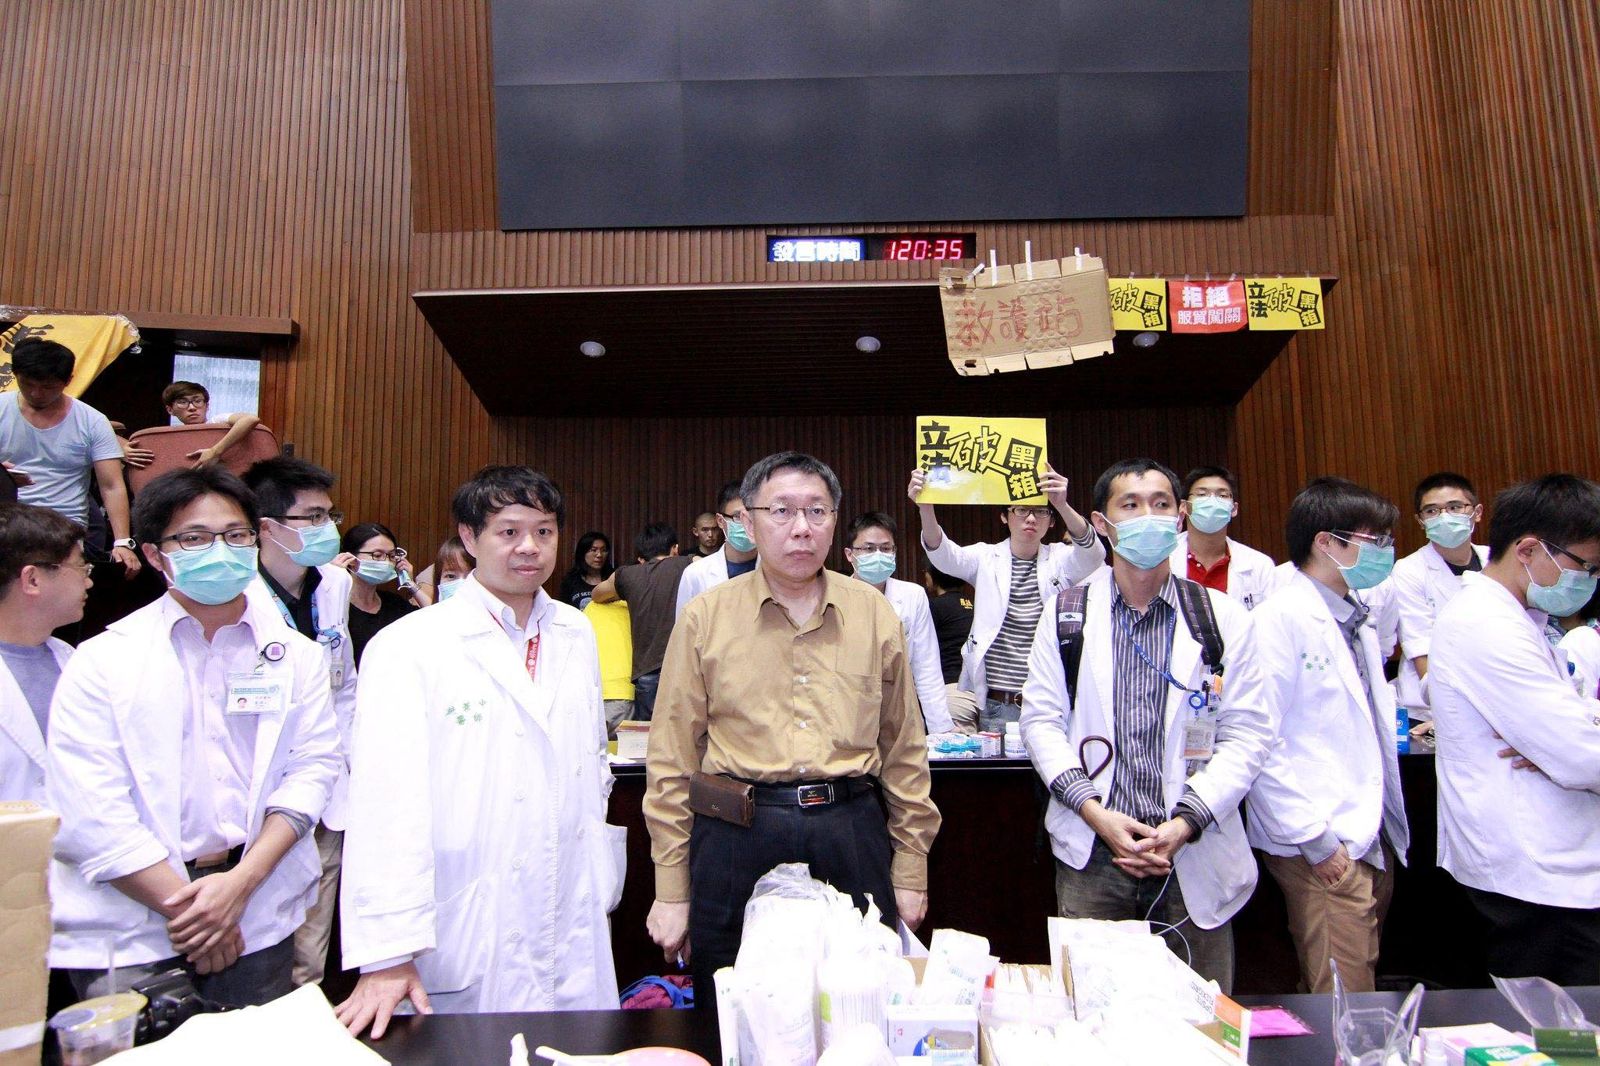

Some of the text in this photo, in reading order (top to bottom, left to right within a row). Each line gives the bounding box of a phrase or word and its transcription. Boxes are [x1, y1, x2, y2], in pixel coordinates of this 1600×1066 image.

[890, 239, 963, 261] 120:35
[1141, 291, 1164, 328] 黑箱
[1182, 286, 1231, 308] 拒絕
[1248, 281, 1268, 318] 立法
[1265, 283, 1302, 313] 破
[1299, 290, 1320, 327] 黑箱
[955, 295, 1083, 347] 救護站
[946, 425, 1012, 476] 破
[1006, 441, 1041, 500] 黑箱
